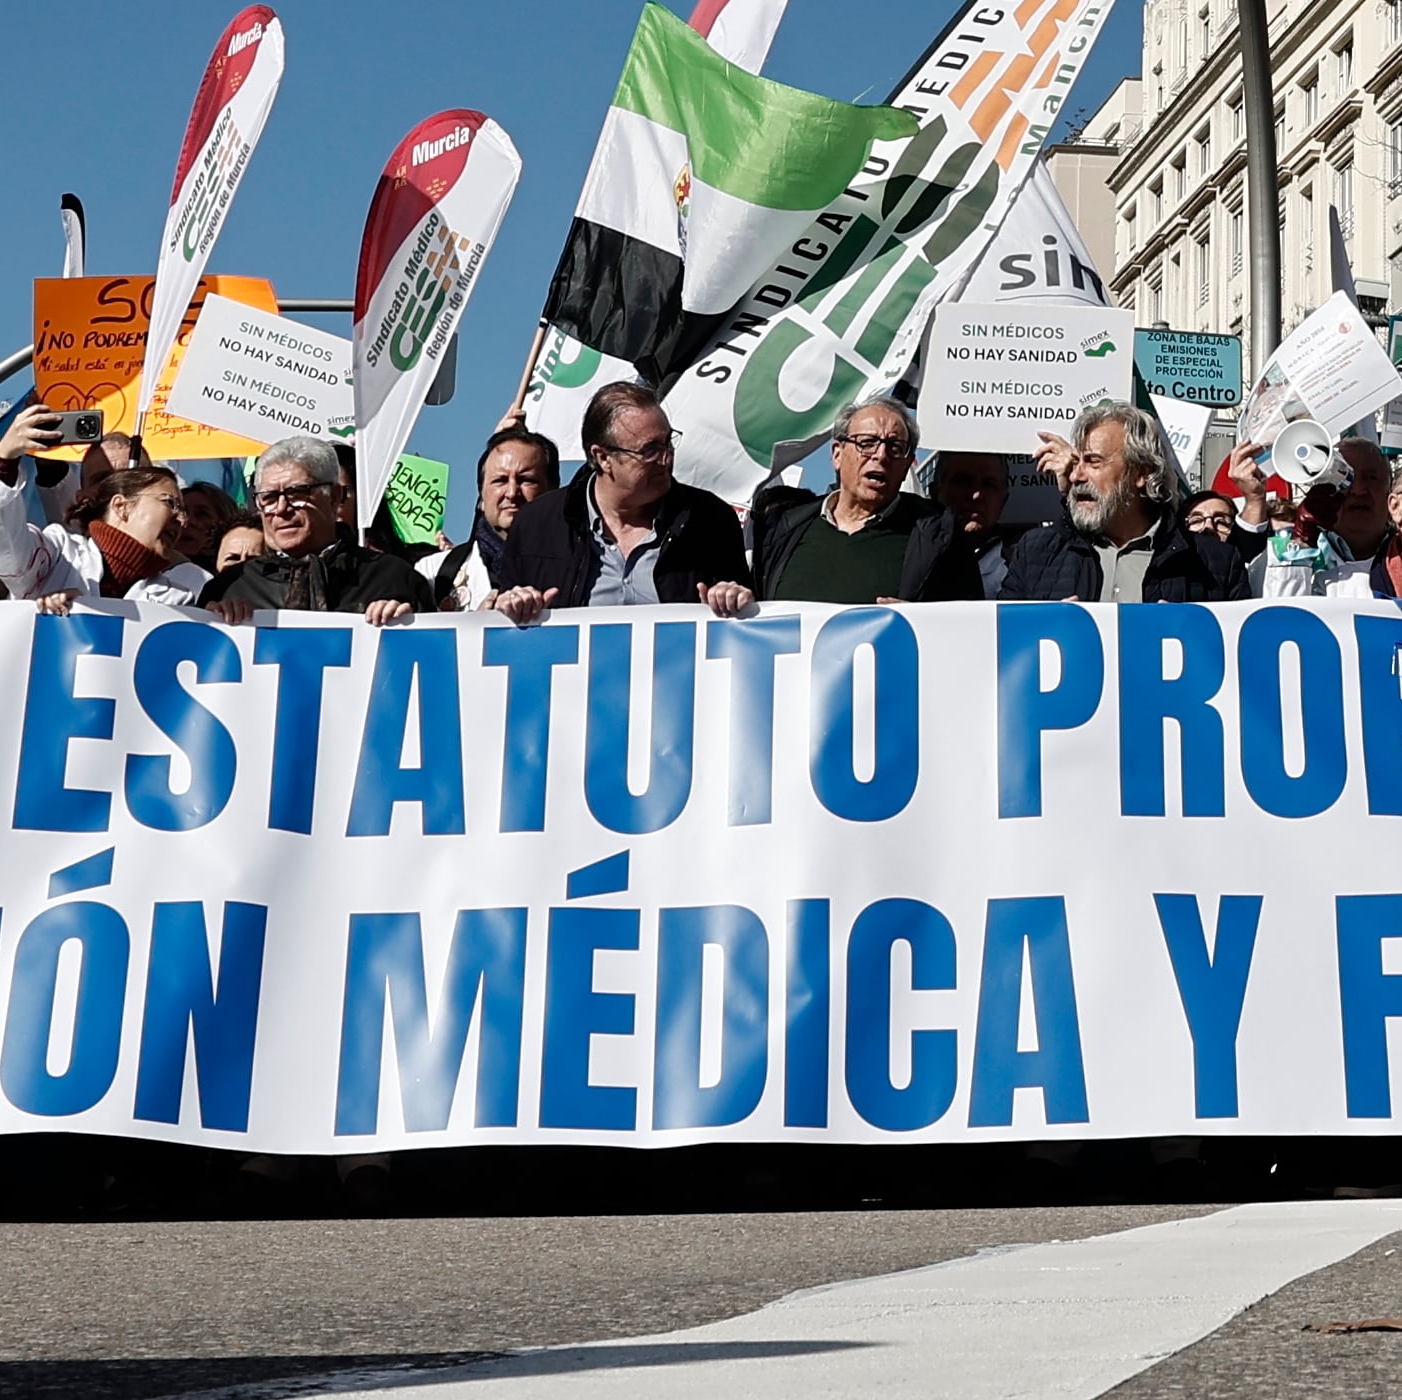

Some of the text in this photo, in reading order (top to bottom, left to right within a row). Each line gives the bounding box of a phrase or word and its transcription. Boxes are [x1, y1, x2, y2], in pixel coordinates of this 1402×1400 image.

[227, 21, 264, 57] Murcia
[412, 125, 471, 167] Murcia
[171, 107, 232, 252] Sindicato Médico
[198, 143, 251, 255] Región de Murcia
[366, 213, 439, 368] Sindicato Médico
[390, 226, 470, 372] CESM
[426, 241, 486, 360] Región de Murcia
[239, 321, 334, 362] SIN MÉDICOS
[961, 322, 1065, 340] SIN MÉDICOS
[1080, 329, 1109, 349] simex
[1147, 332, 1230, 347] ZONA DE BAJAS
[1161, 344, 1218, 356] EMISIONES
[219, 337, 242, 352] NO
[244, 345, 274, 363] HAY
[275, 355, 338, 386] SANIDAD
[946, 347, 1078, 364] NO HAY SANIDAD
[1155, 355, 1224, 368] DE ESPECIAL
[1155, 366, 1223, 379] PROTECCIÓN
[222, 370, 317, 411] SIN MÉDICOS
[960, 380, 1063, 396] SIN MÉDICOS
[1078, 386, 1108, 406] simex
[1172, 381, 1236, 402] Centro
[201, 386, 322, 435] NO HAY SANIDAD
[945, 404, 1076, 421] NO HAY SANIDAD
[12, 604, 921, 836] ESTATUTO
[333, 849, 1091, 1137] MÉDICA
[1151, 893, 1264, 1120] Y
